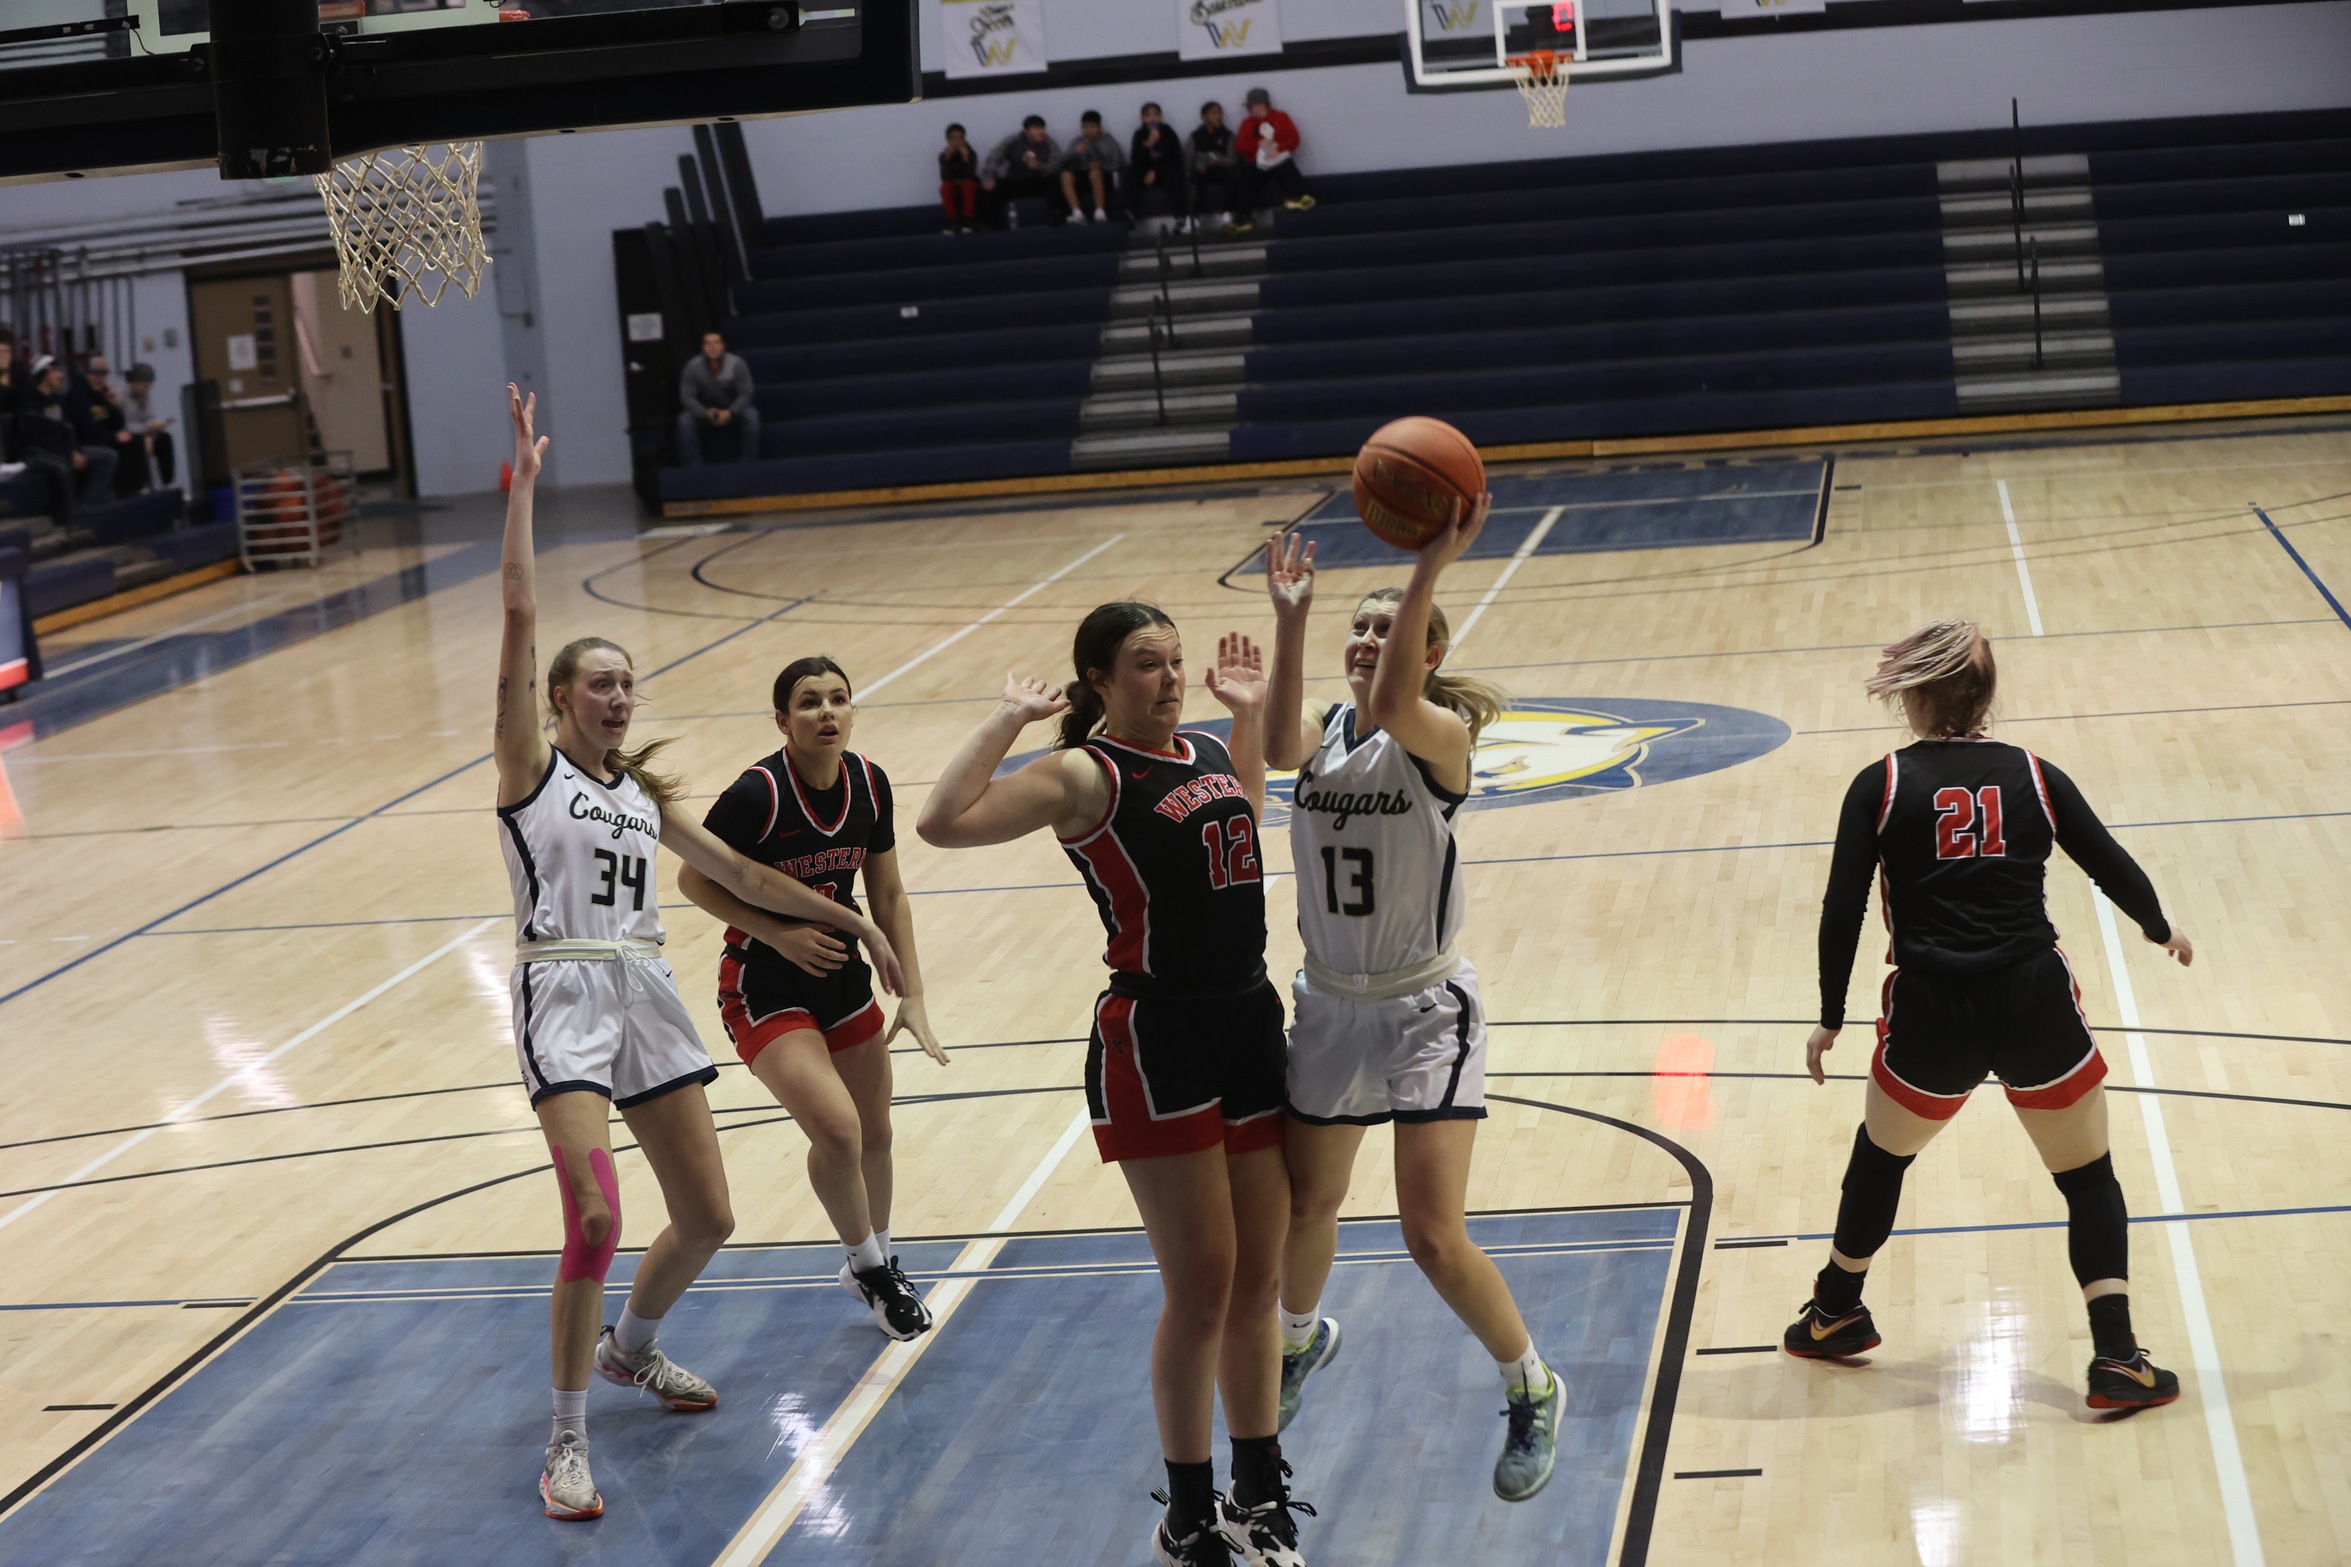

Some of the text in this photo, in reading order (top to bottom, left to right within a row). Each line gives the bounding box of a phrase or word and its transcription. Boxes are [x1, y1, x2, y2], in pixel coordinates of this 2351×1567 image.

[569, 791, 658, 839] Cougars
[1294, 770, 1413, 831] Cougars
[1933, 785, 2006, 860] 21
[590, 847, 647, 911] 34
[1202, 813, 1261, 890] 12
[1320, 846, 1375, 917] 13
